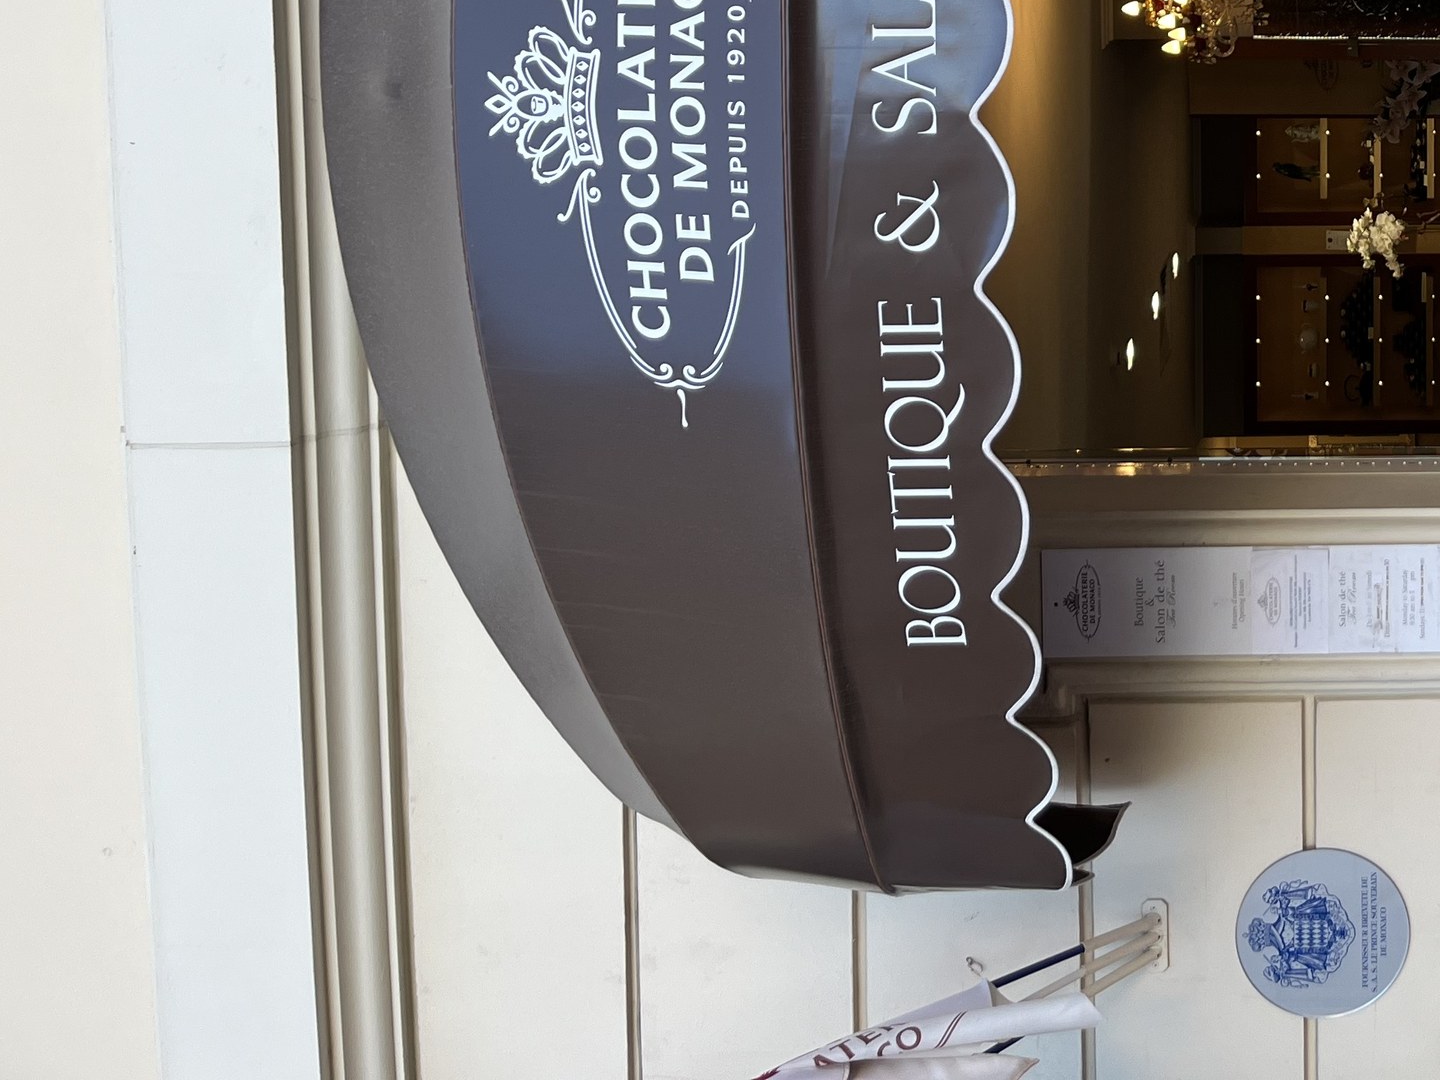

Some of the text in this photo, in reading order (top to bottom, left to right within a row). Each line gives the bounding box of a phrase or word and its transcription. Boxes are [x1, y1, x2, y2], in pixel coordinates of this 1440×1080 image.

[726, 5, 750, 219] DEPUIS 1920
[874, 180, 940, 252] &
[675, 213, 715, 282] DE
[877, 297, 967, 647] BOUTIQUE
[1090, 614, 1096, 624] DE
[1134, 576, 1146, 626] Boutique
[1144, 598, 1154, 607] &
[1154, 560, 1166, 644] Salon de thé
[1166, 574, 1176, 628] Tea Room
[1338, 571, 1346, 627] Salon de thé
[1361, 876, 1369, 988] FOURNISSEUR BREVETE DE
[1371, 952, 1378, 964] LE
[1380, 944, 1387, 956] DE
[1371, 965, 1378, 973] S.
[1371, 974, 1378, 983] A.
